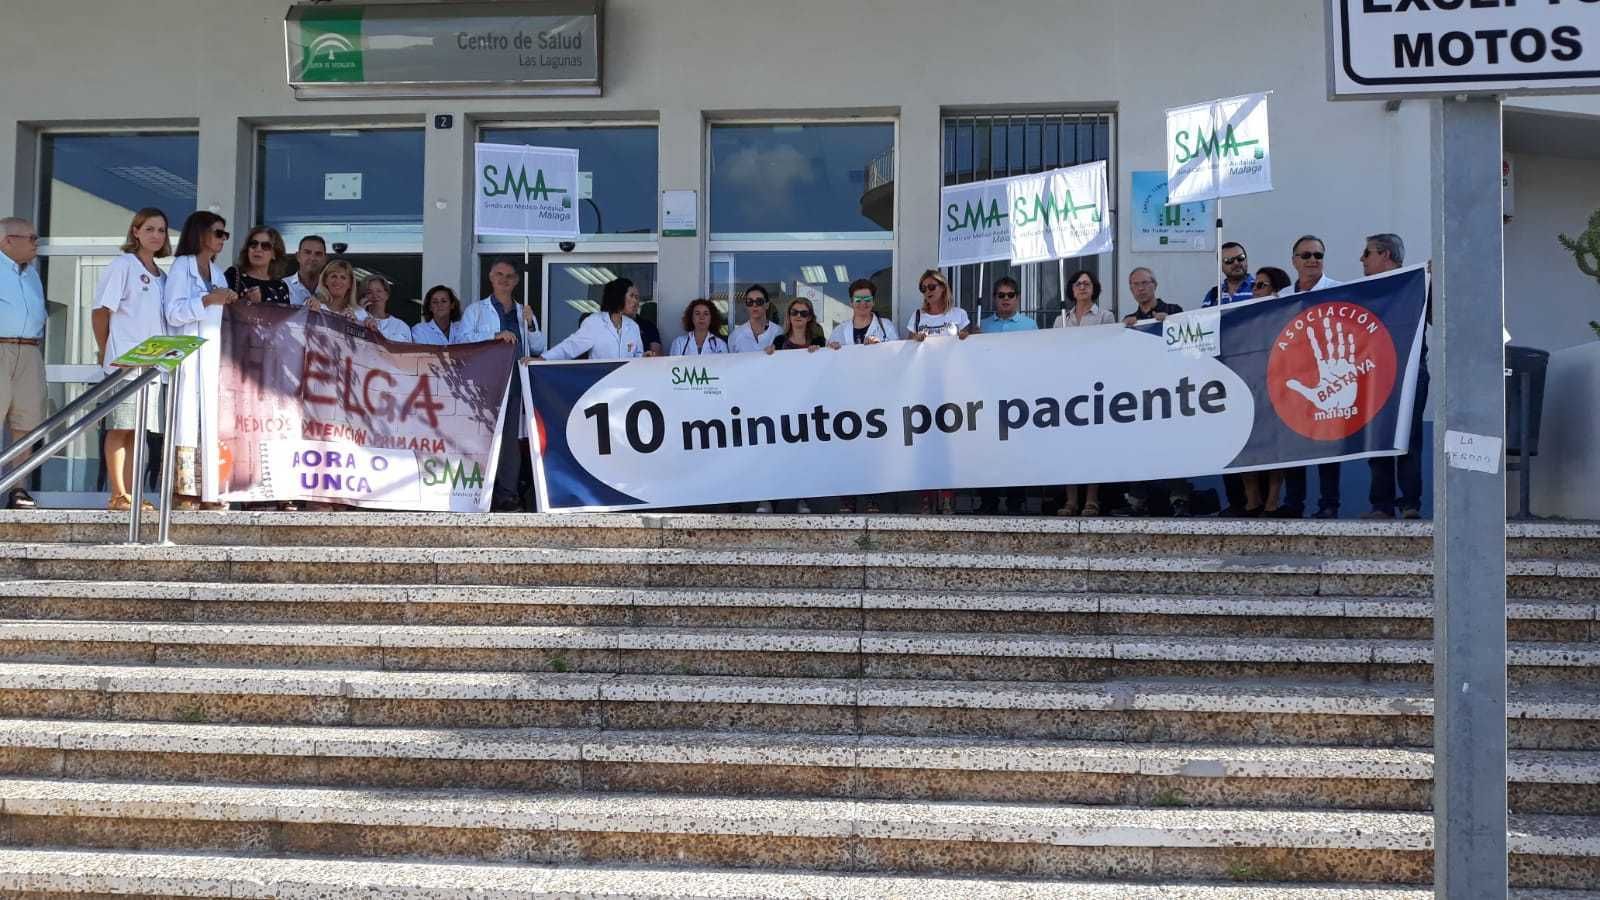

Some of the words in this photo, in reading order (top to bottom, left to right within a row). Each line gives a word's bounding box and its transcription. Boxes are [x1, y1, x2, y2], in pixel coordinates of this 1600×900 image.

[457, 31, 508, 50] Centro
[514, 30, 532, 50] de
[538, 30, 582, 50] Salud
[1394, 26, 1583, 68] MOTOS
[519, 54, 537, 66] Las
[540, 55, 582, 68] Lagunas
[1175, 123, 1259, 163] SMA
[483, 164, 567, 202] SMA
[947, 196, 1009, 232] SMA
[1014, 190, 1096, 227] SMA
[1278, 306, 1378, 351] ASOCIACIÓN
[672, 366, 719, 386] SMA
[584, 399, 665, 455] 10
[682, 405, 888, 450] minutos
[903, 400, 984, 446] por
[999, 376, 1227, 440] paciente
[423, 459, 484, 490] SMA
